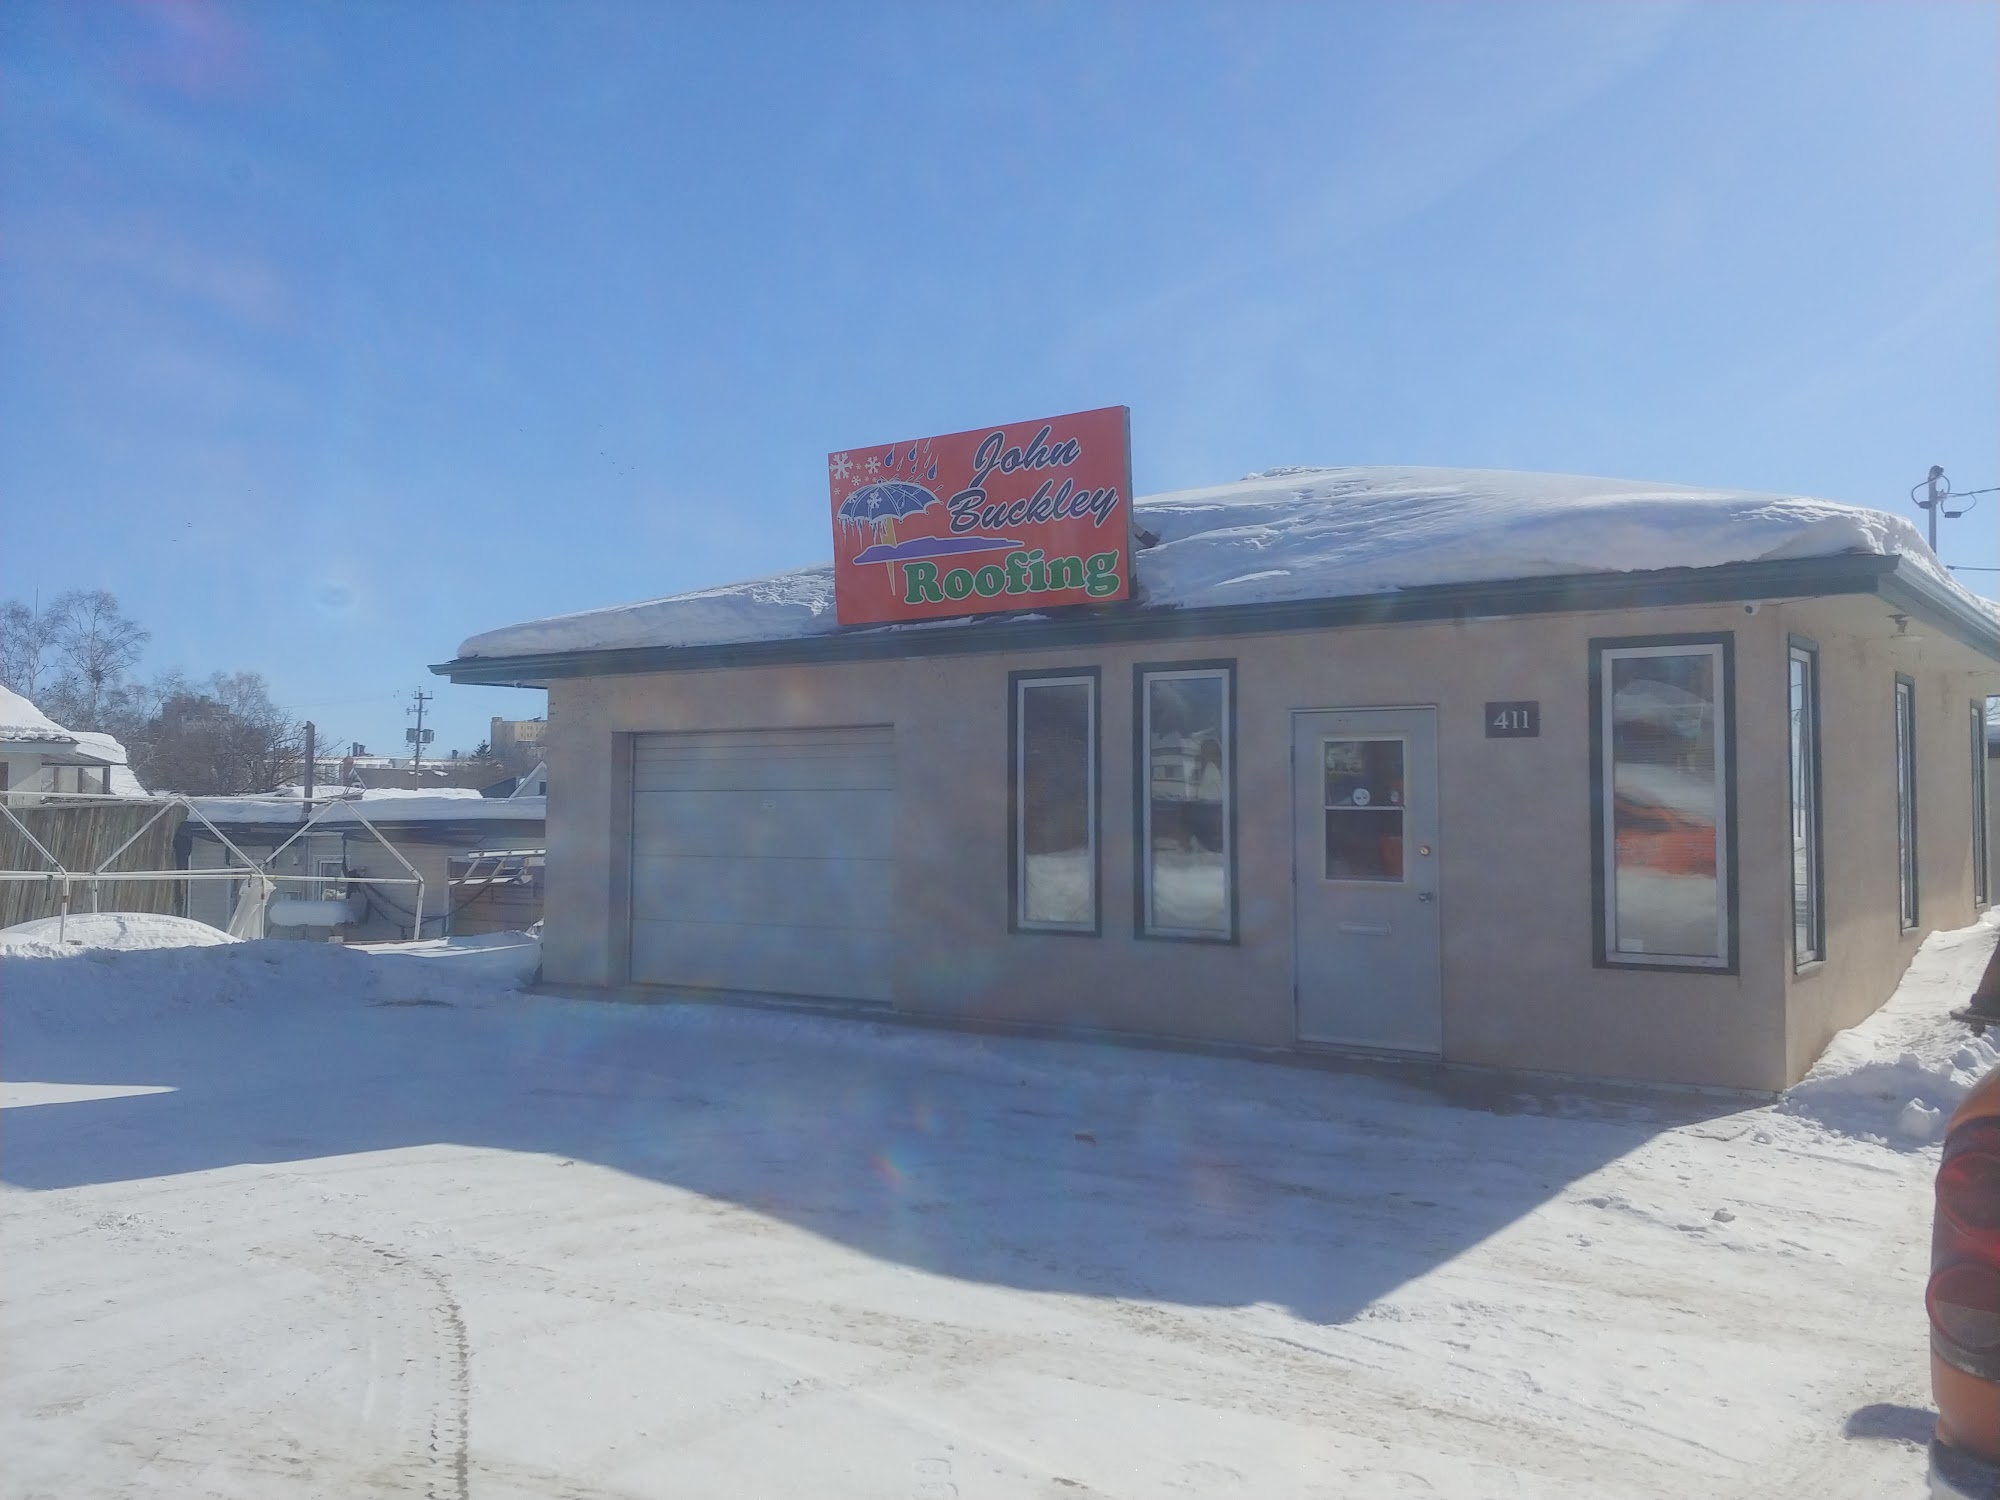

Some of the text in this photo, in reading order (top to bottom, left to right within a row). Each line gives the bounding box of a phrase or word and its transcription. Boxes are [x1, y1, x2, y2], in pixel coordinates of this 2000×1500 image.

[969, 425, 1081, 489] John
[947, 478, 1119, 533] Buckley
[903, 549, 1120, 604] Roofing
[1493, 710, 1530, 729] 411
